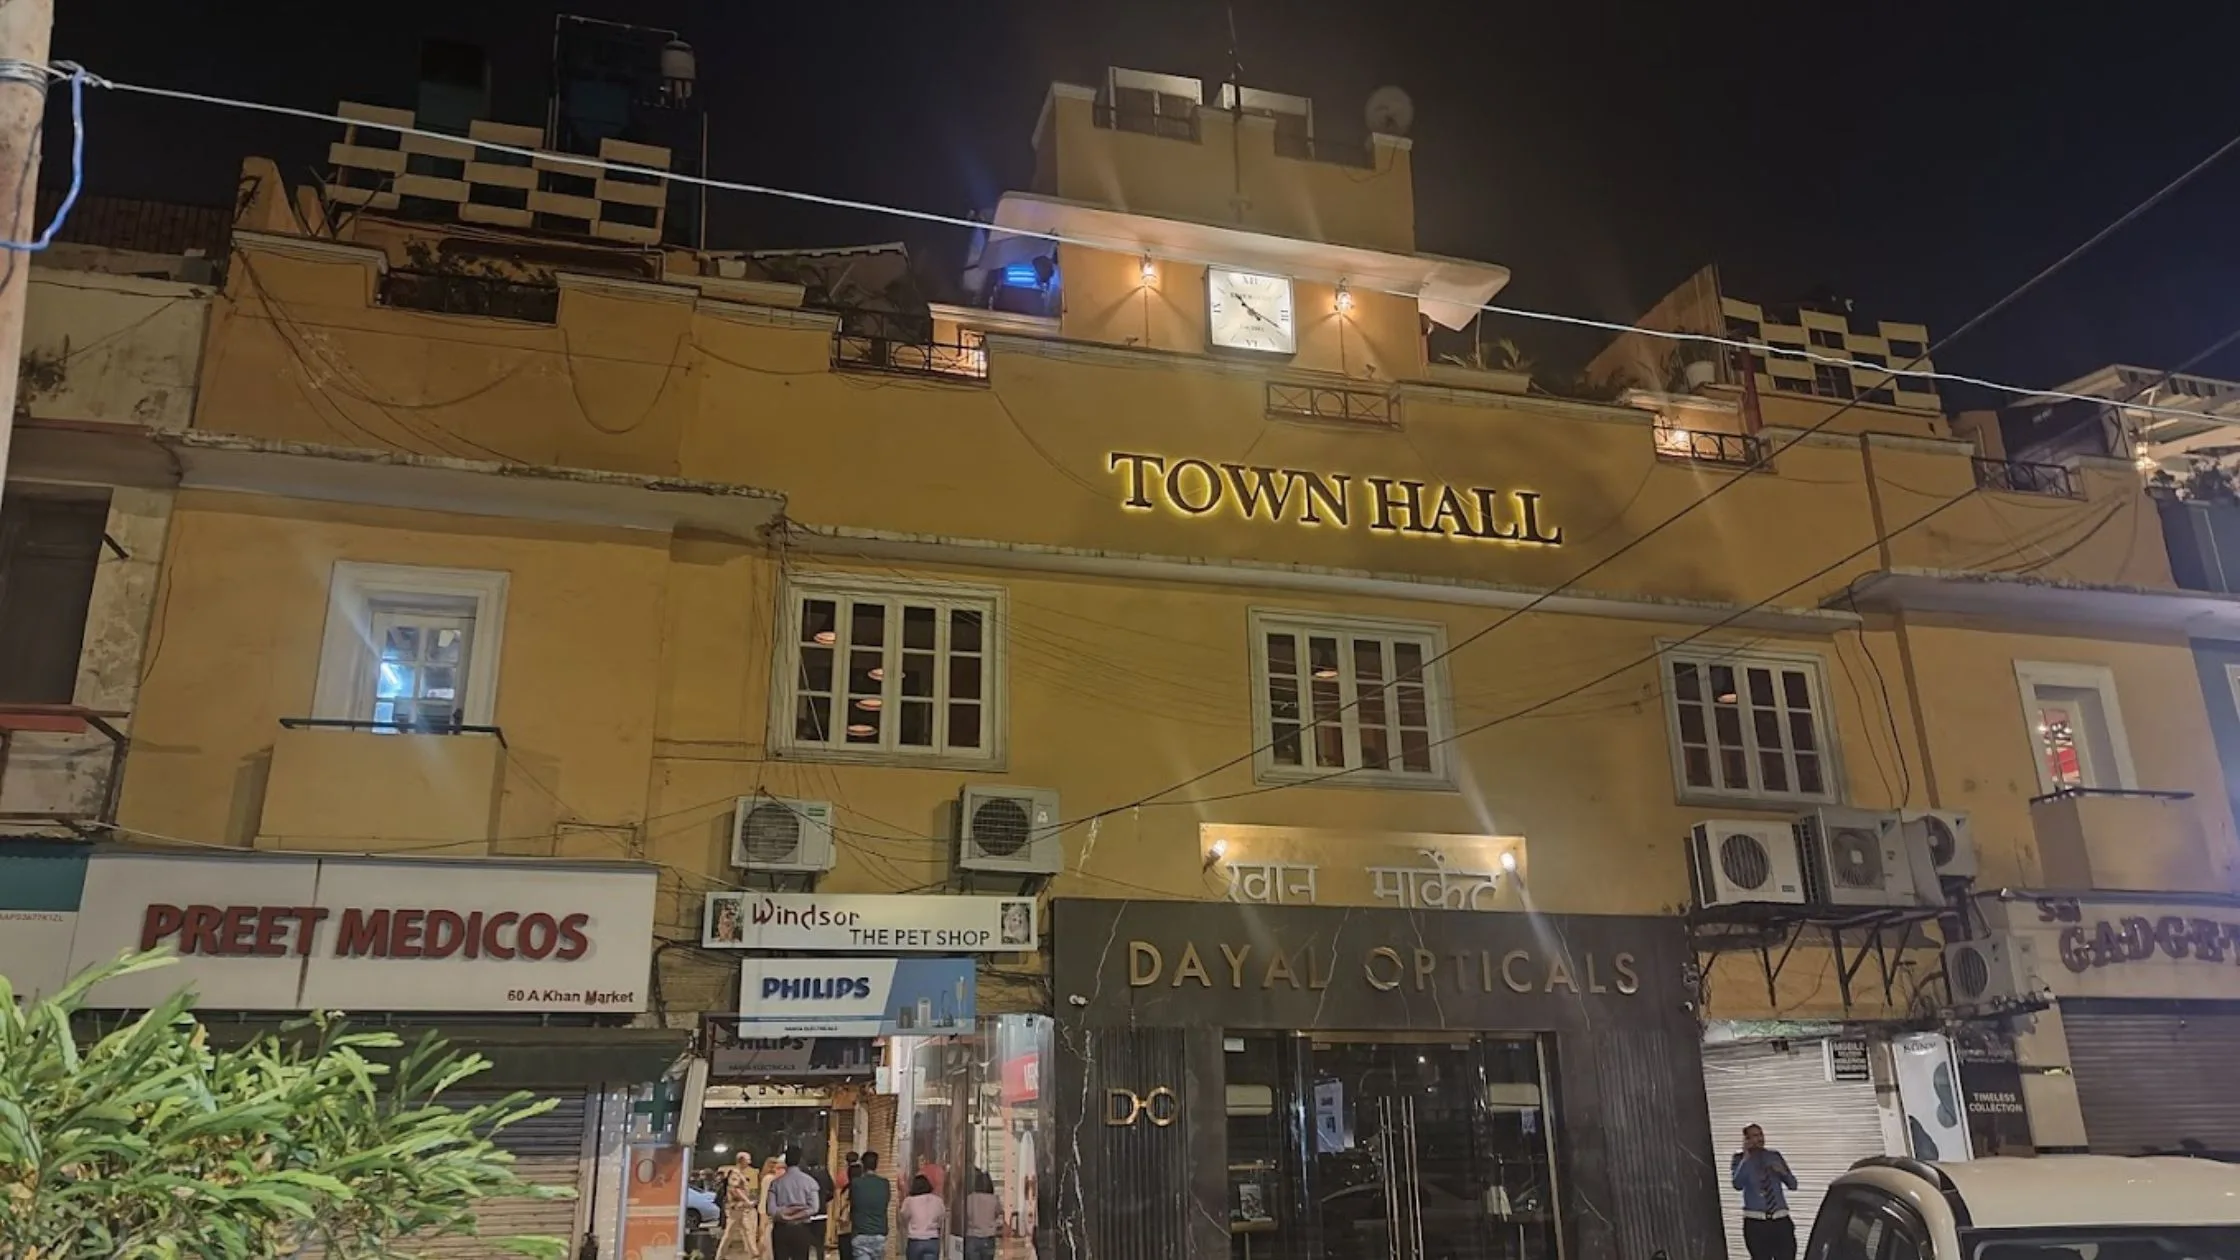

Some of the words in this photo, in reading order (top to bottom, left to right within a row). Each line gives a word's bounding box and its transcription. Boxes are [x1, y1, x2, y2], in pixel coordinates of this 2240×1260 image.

[1107, 450, 1352, 529] TOWN
[1366, 476, 1564, 548] HALL
[1226, 862, 1319, 905] खान
[752, 898, 861, 931] Windsor
[140, 903, 329, 957] PREET
[336, 908, 589, 960] MEDICOS
[850, 929, 889, 945] THE
[895, 930, 932, 946] PET
[936, 930, 991, 946] SHOP
[1128, 940, 1332, 990] DAYAL
[1364, 947, 1640, 996] OPTICALS
[507, 989, 525, 1002] 60
[528, 989, 540, 1002] A
[543, 989, 581, 1002] Khan
[585, 989, 634, 1004] Market
[761, 976, 871, 1001] PHILIPS
[1969, 1103, 2024, 1113] COLLECTION
[1973, 1092, 2016, 1102] TIMELESS
